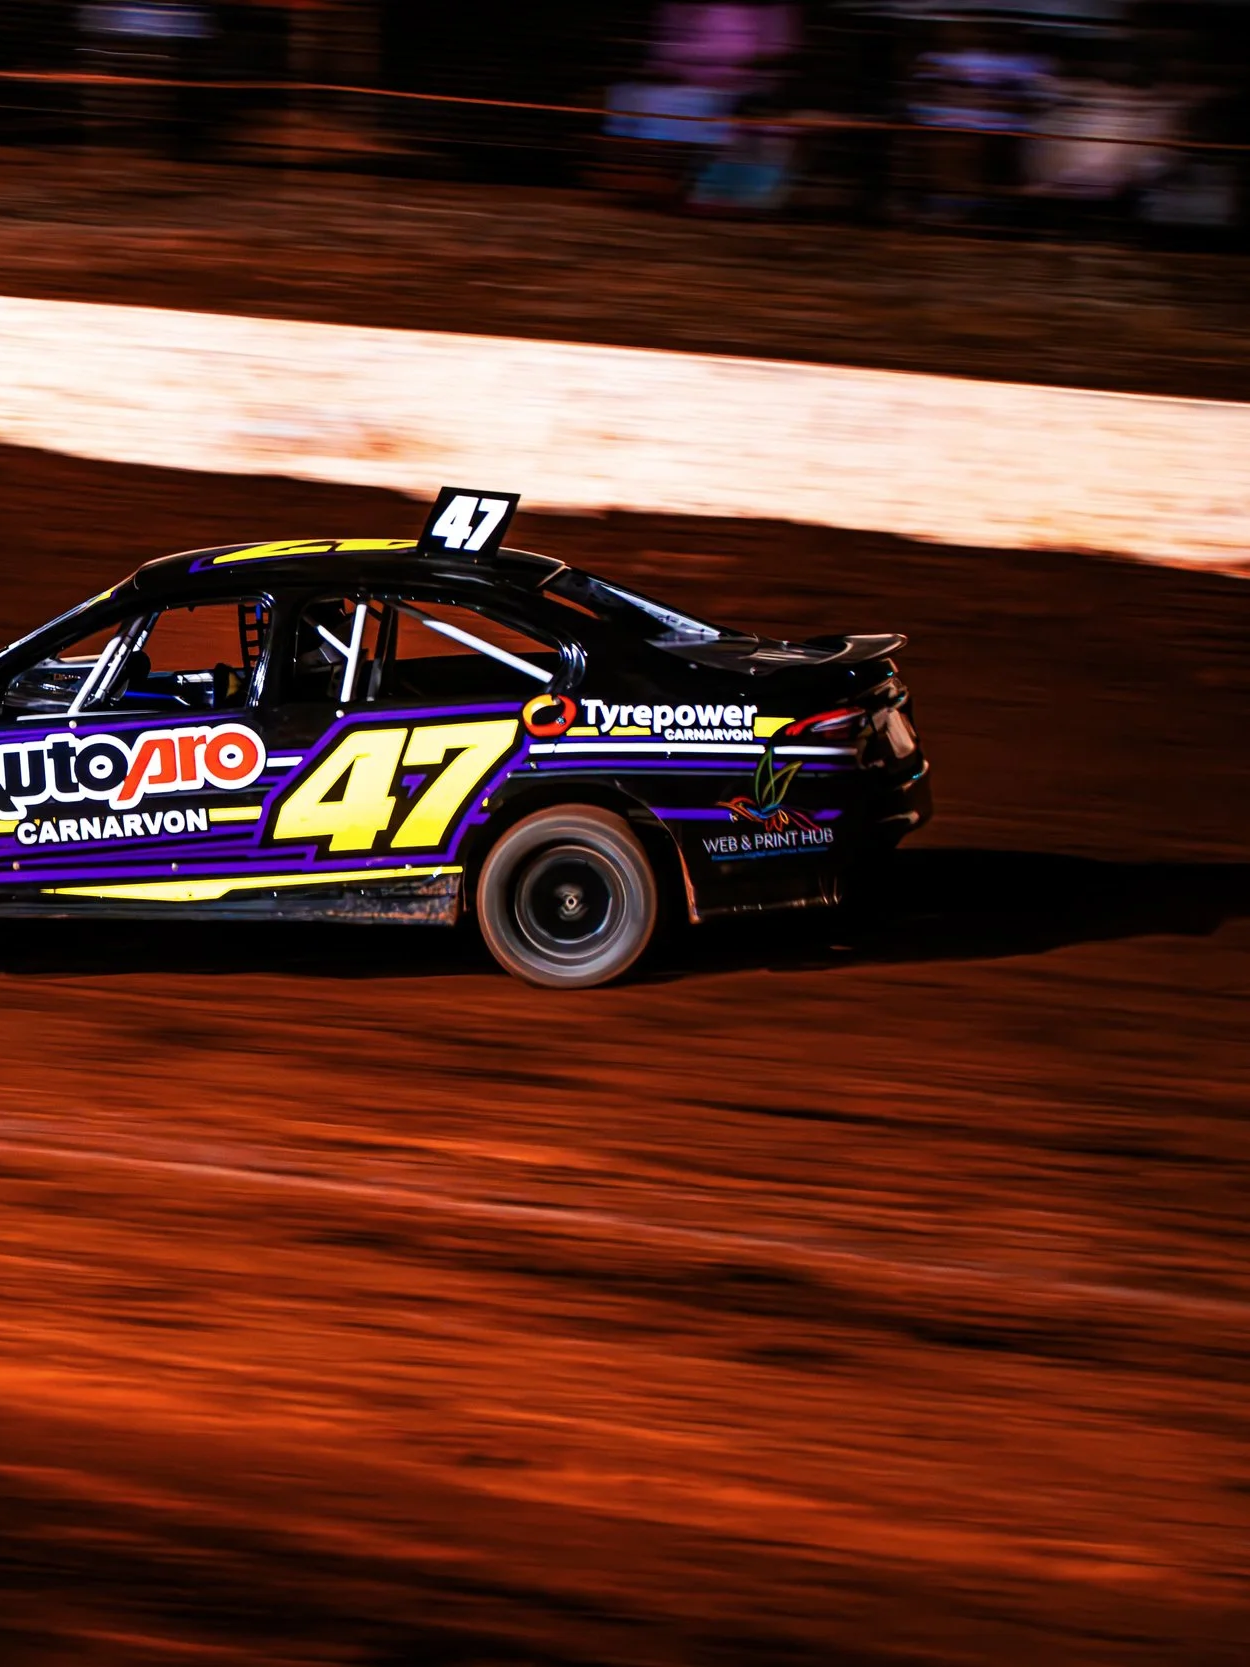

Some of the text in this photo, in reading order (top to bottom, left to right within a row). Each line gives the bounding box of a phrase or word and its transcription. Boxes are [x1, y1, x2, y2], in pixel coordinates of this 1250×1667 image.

[431, 494, 510, 552] 47
[582, 698, 758, 733] Tyrepower
[664, 728, 754, 741] CARNARVON
[272, 719, 519, 851] 47
[16, 808, 209, 845] CARNARVON
[702, 827, 834, 853] WEB & PRINT HUB
